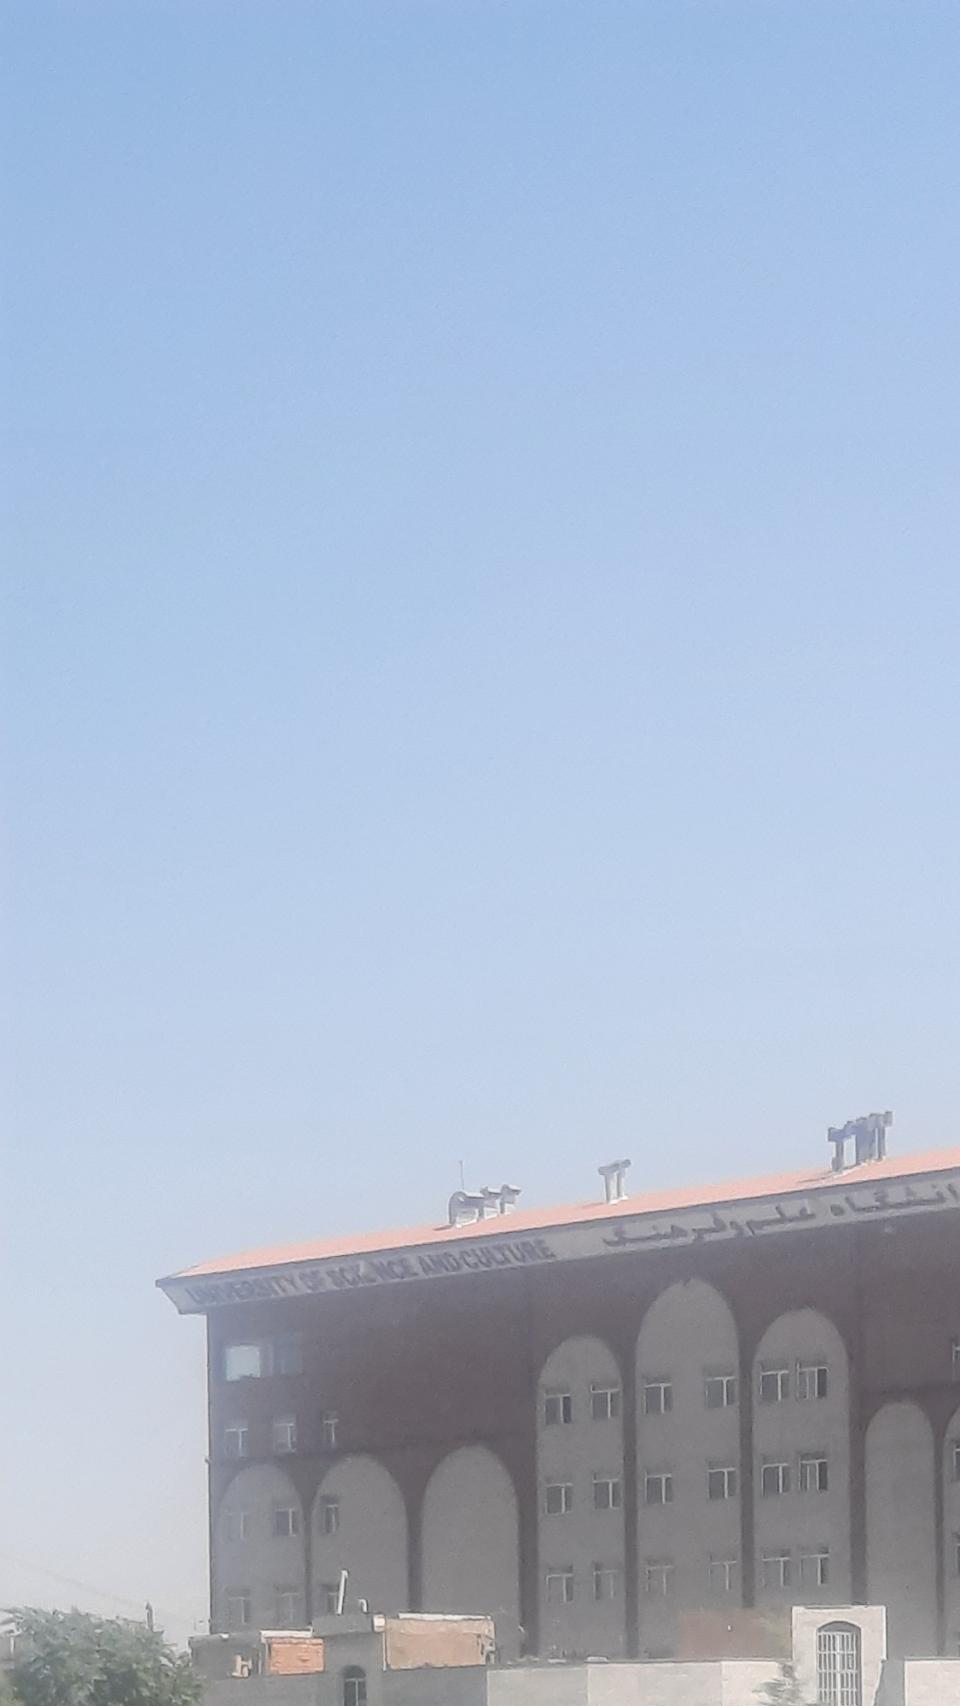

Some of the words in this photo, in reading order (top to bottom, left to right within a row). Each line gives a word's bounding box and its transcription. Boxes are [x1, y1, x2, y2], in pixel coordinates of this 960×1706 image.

[747, 1203, 815, 1235] علم
[419, 1251, 461, 1276] AND
[461, 1238, 556, 1269] CULTURE
